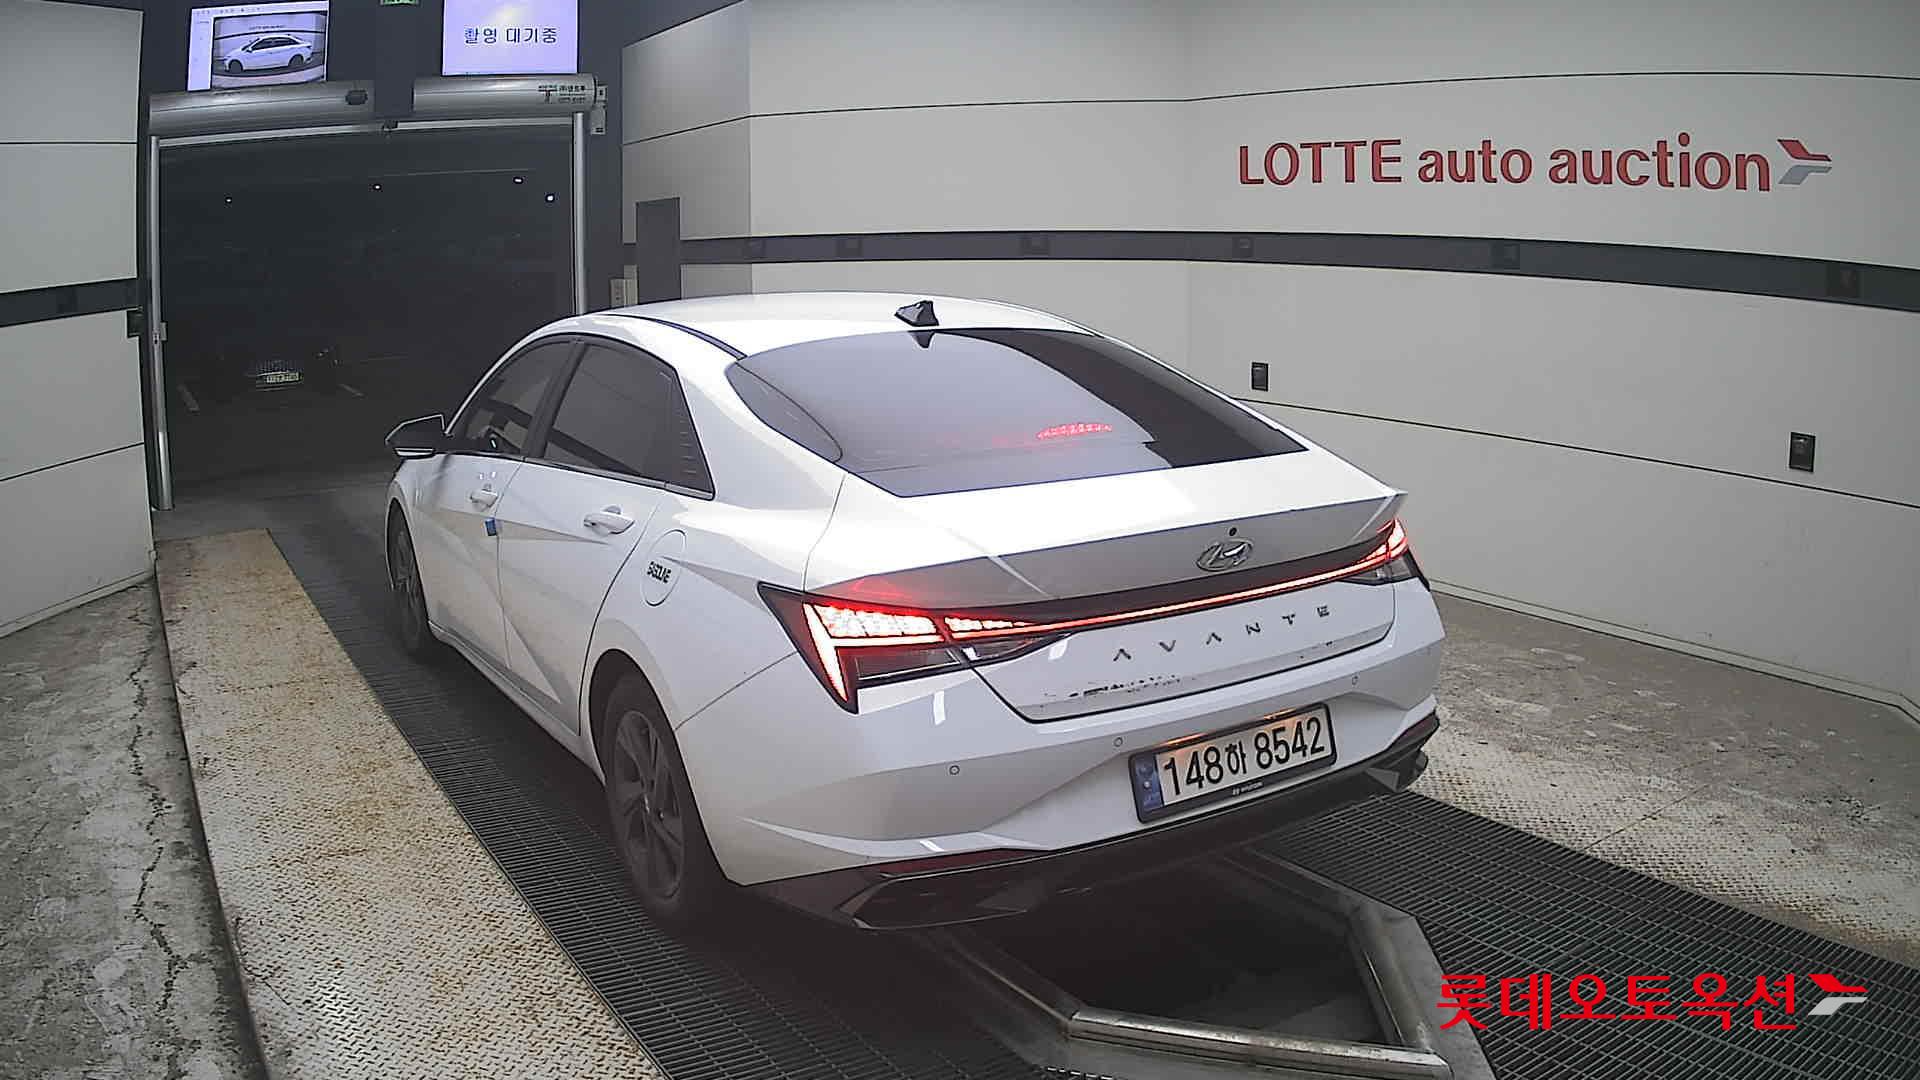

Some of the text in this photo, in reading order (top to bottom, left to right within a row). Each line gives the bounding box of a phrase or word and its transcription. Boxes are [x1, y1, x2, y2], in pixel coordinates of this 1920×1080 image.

[506, 27, 558, 44] 대기중
[1239, 132, 1770, 192] LOTTE auto auction
[1112, 604, 1331, 662] AVANTE
[1163, 716, 1326, 796] 148하 8542
